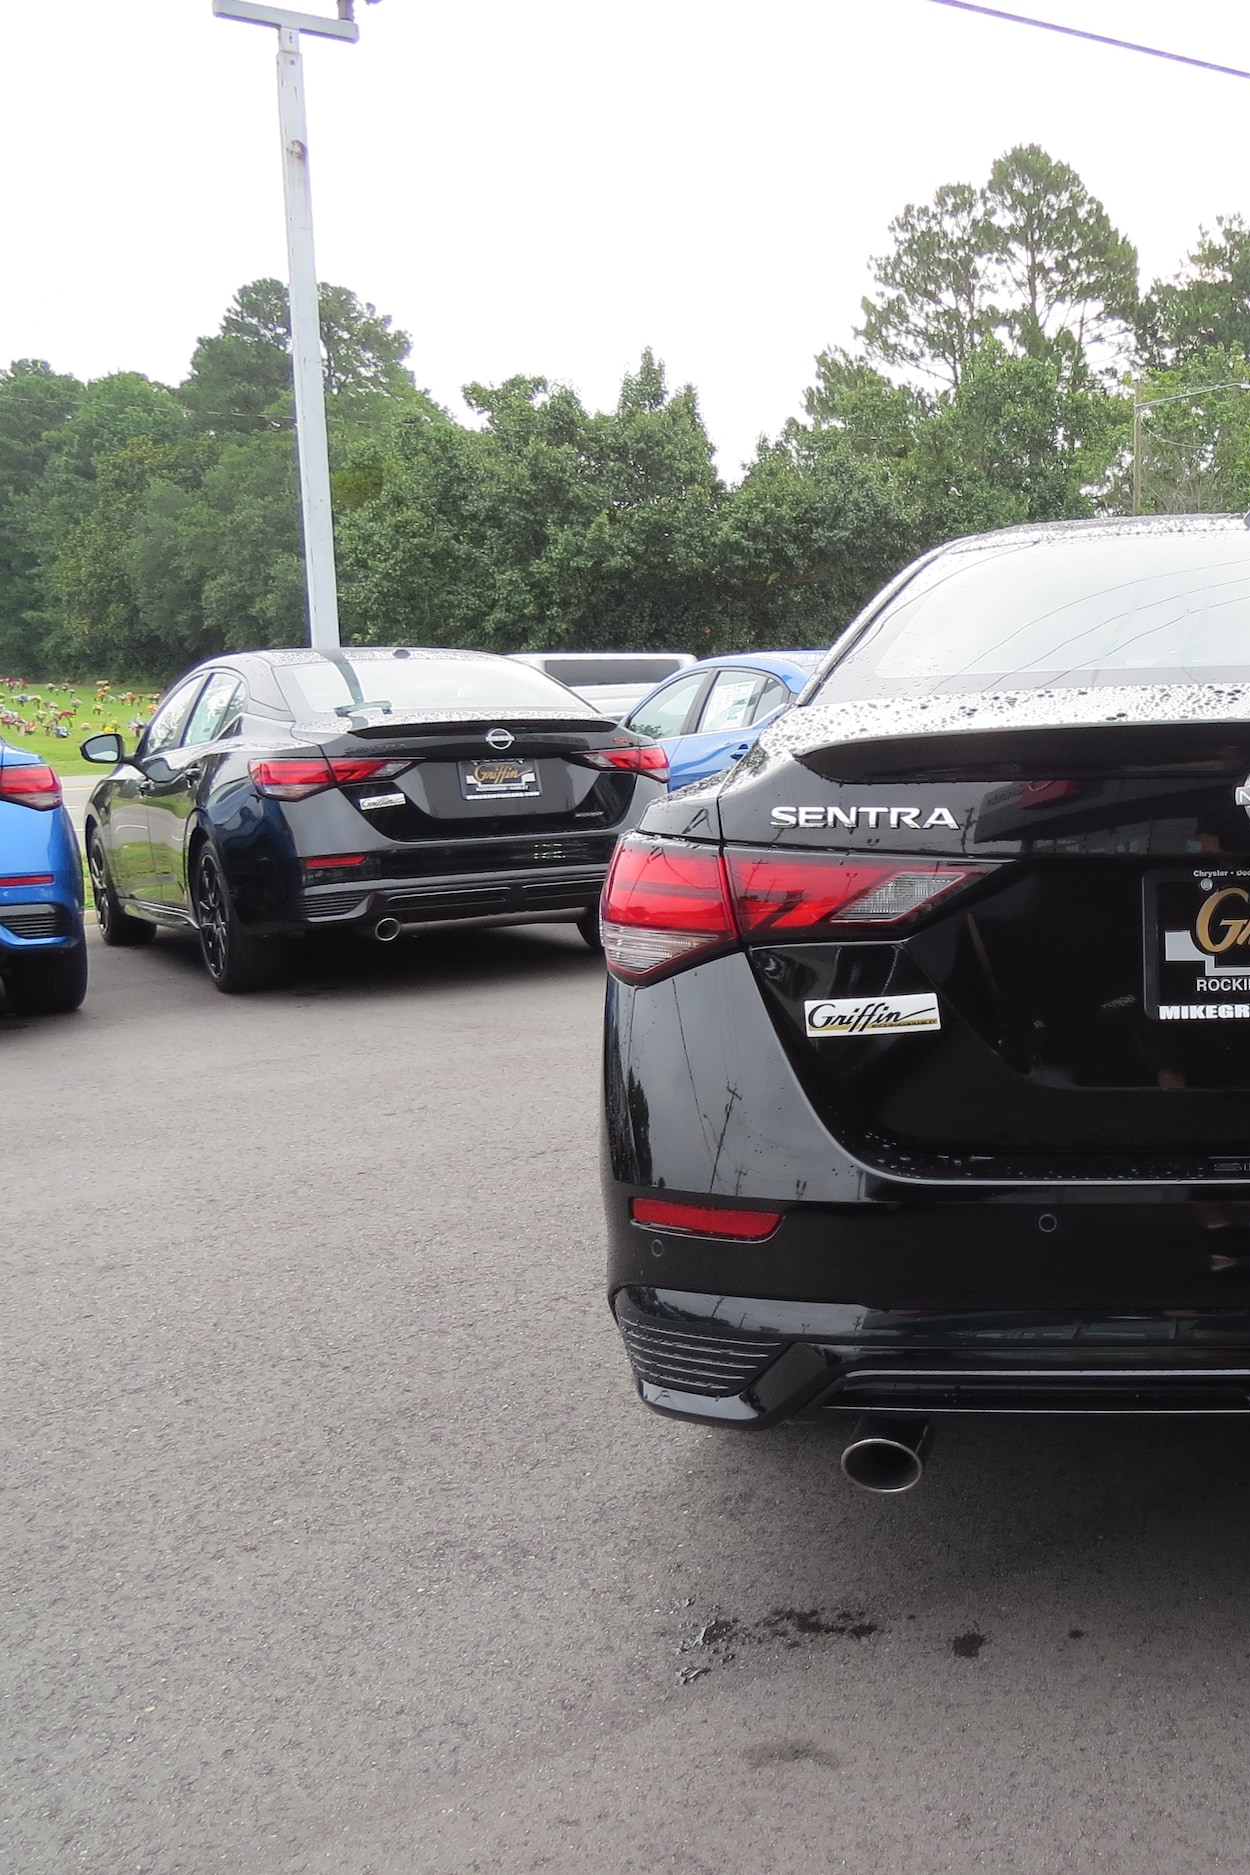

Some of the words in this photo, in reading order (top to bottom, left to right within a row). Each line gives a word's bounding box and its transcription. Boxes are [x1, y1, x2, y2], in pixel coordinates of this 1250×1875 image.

[769, 806, 960, 829] SENTRA
[1193, 869, 1228, 878] Chrysler
[808, 1003, 936, 1032] Griffin
